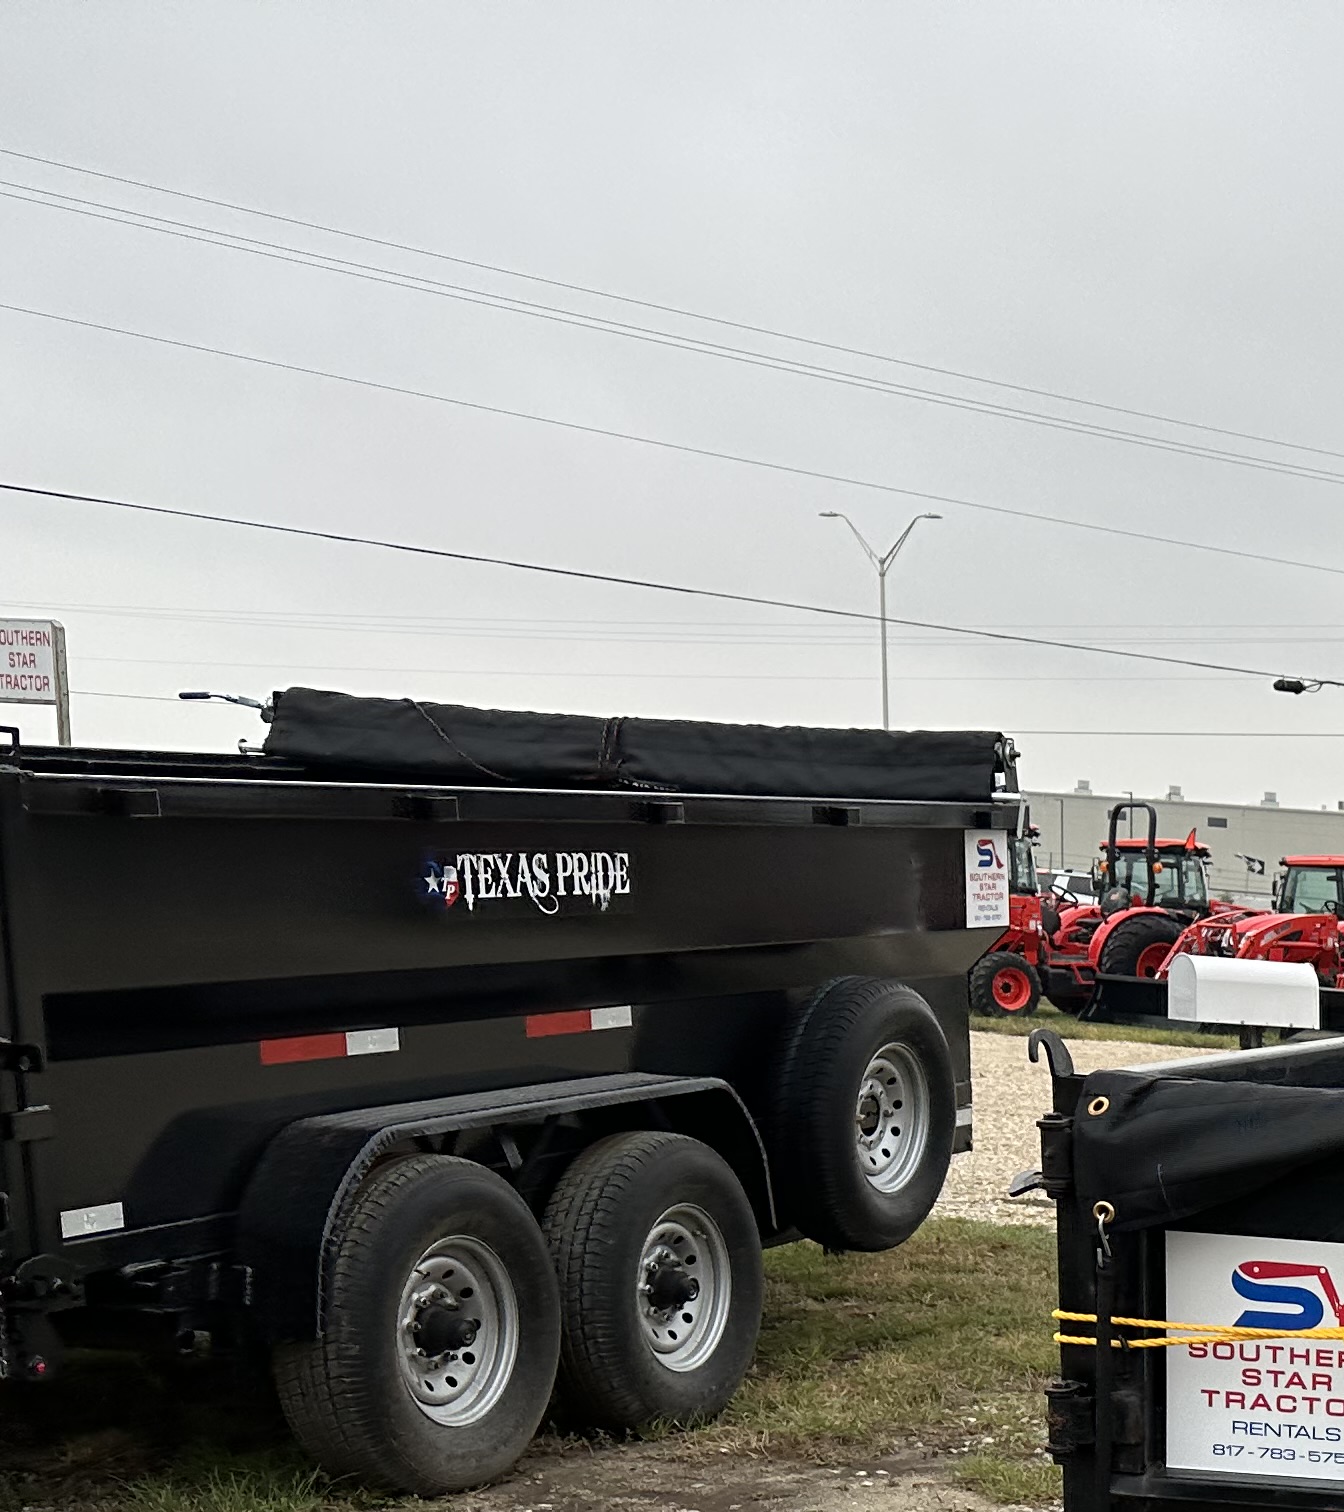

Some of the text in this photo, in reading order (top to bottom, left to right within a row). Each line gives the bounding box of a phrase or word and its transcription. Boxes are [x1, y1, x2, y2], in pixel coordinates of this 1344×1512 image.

[0, 629, 51, 647] OUTHERN
[9, 652, 37, 669] STAR
[0, 674, 50, 692] TRACTOR
[456, 852, 631, 911] TEXAS PRIDE
[1241, 1368, 1333, 1392] STAR
[1232, 1420, 1342, 1442] RENTALS
